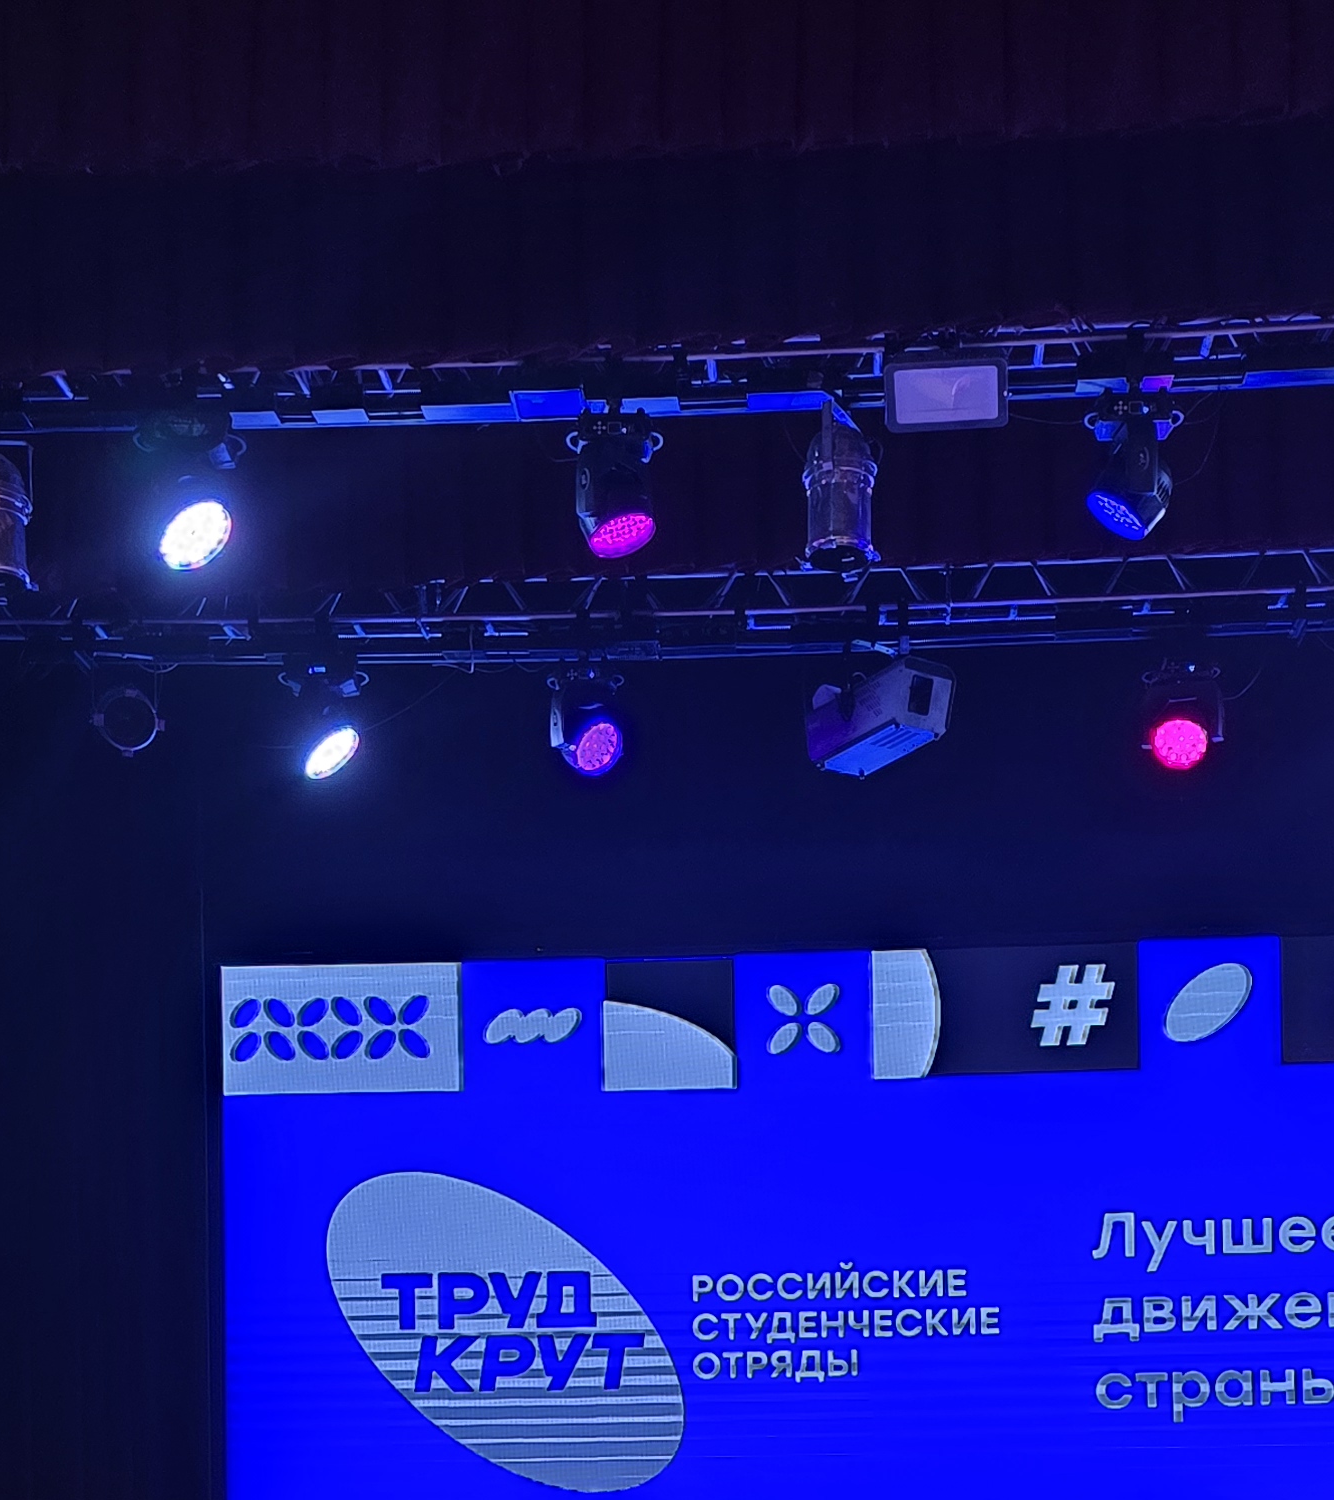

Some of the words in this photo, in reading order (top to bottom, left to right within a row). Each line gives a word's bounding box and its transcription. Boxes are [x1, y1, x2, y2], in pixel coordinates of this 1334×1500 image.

[381, 1271, 597, 1329] ТРУД
[692, 1261, 968, 1302] РОССИЙСКИЕ
[692, 1306, 1001, 1342] СТУДЕНЧЕСКИЕ
[414, 1333, 646, 1392] КРУТ
[692, 1349, 859, 1382] ОТРЯДЫ
